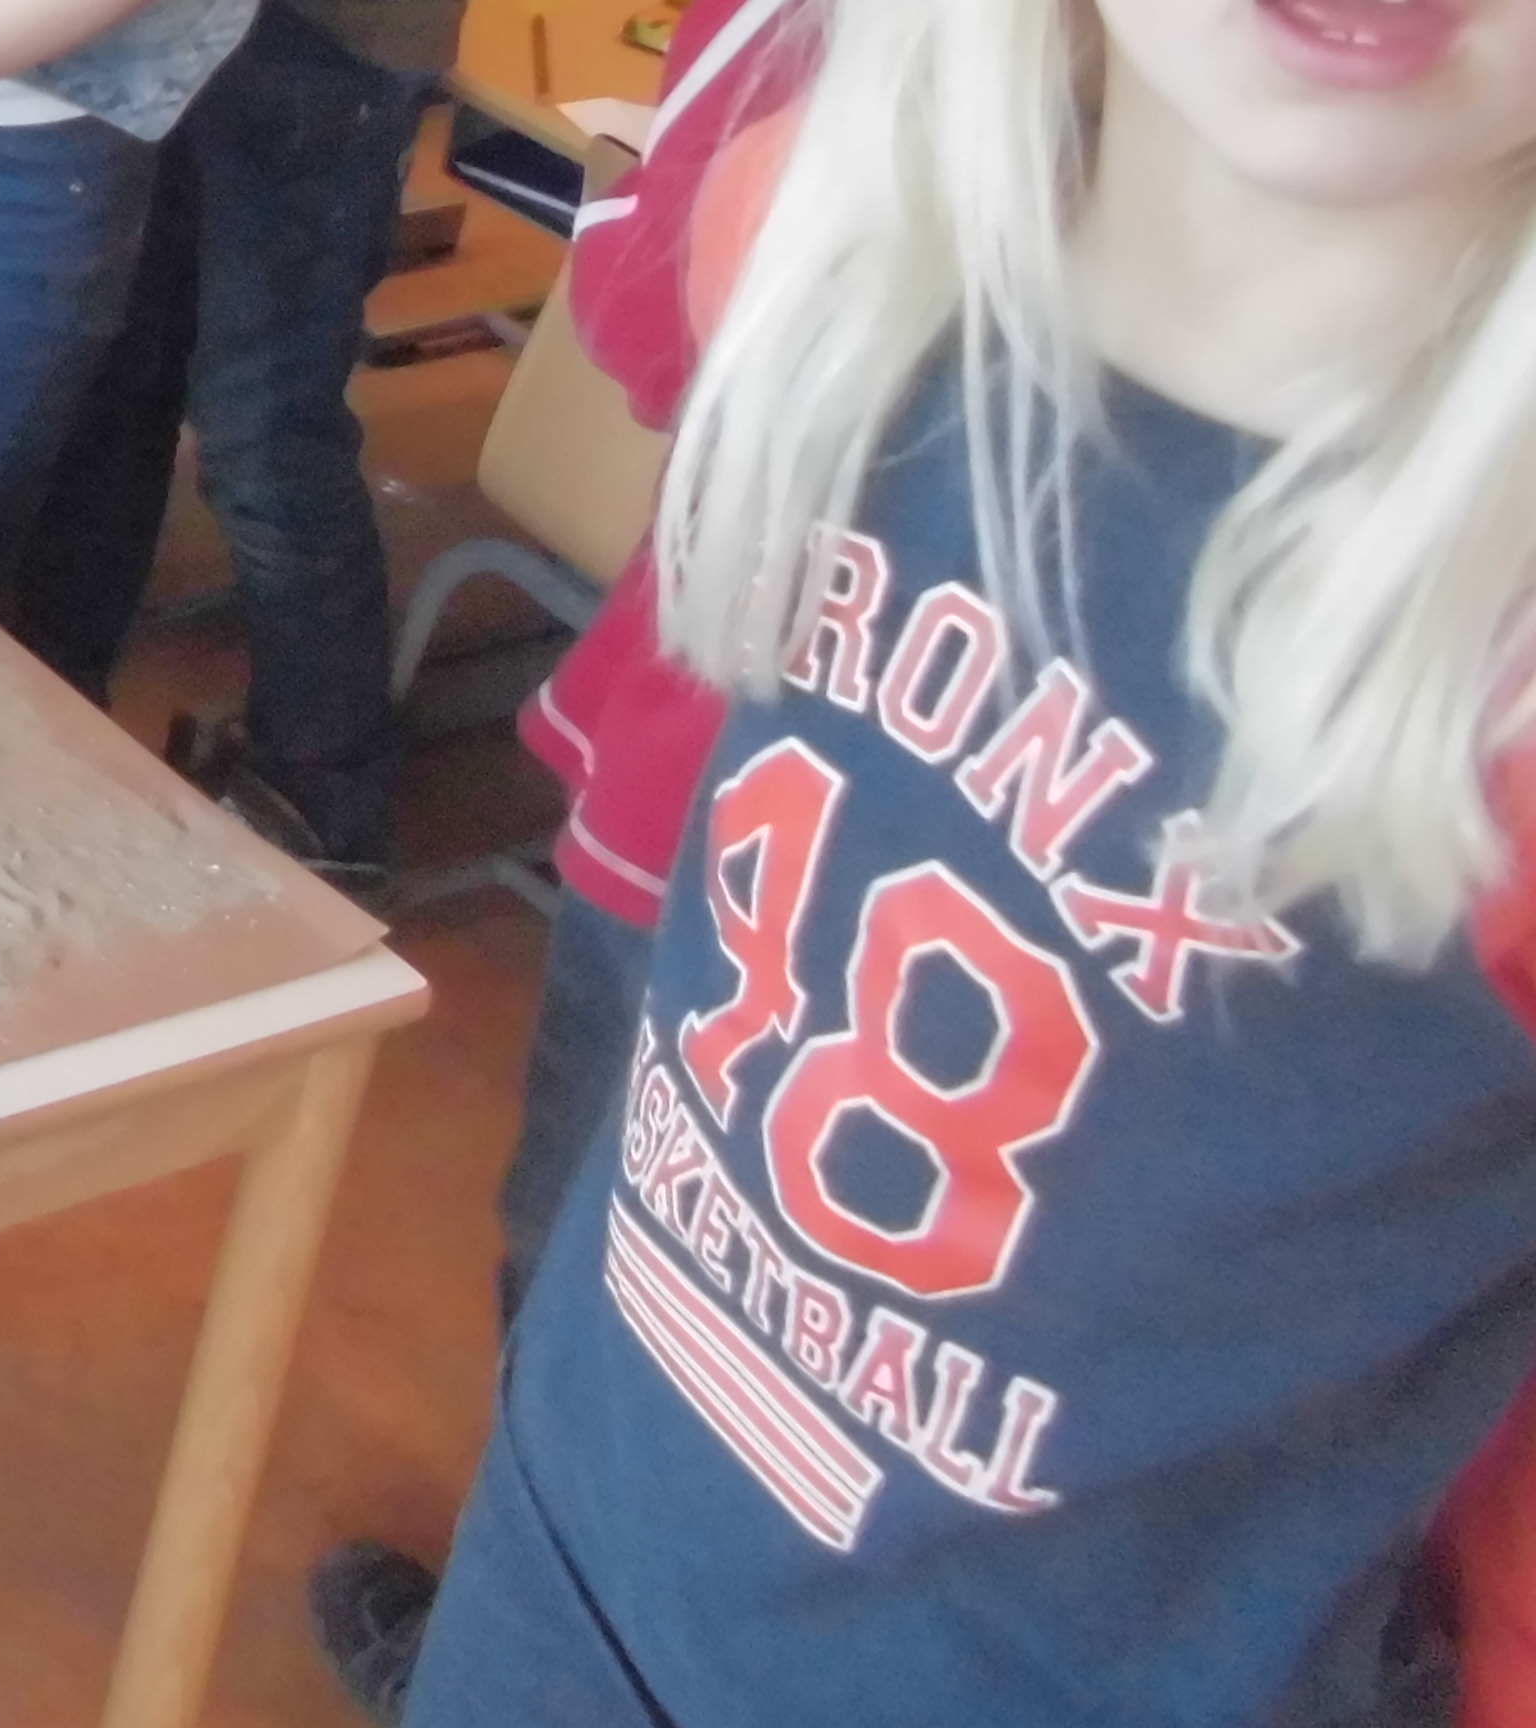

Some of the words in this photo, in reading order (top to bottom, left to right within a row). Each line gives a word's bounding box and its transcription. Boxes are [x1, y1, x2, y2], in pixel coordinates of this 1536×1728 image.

[678, 736, 1099, 1300] 48
[778, 519, 1304, 1024] RONX
[622, 1018, 1060, 1514] SKETBALL
